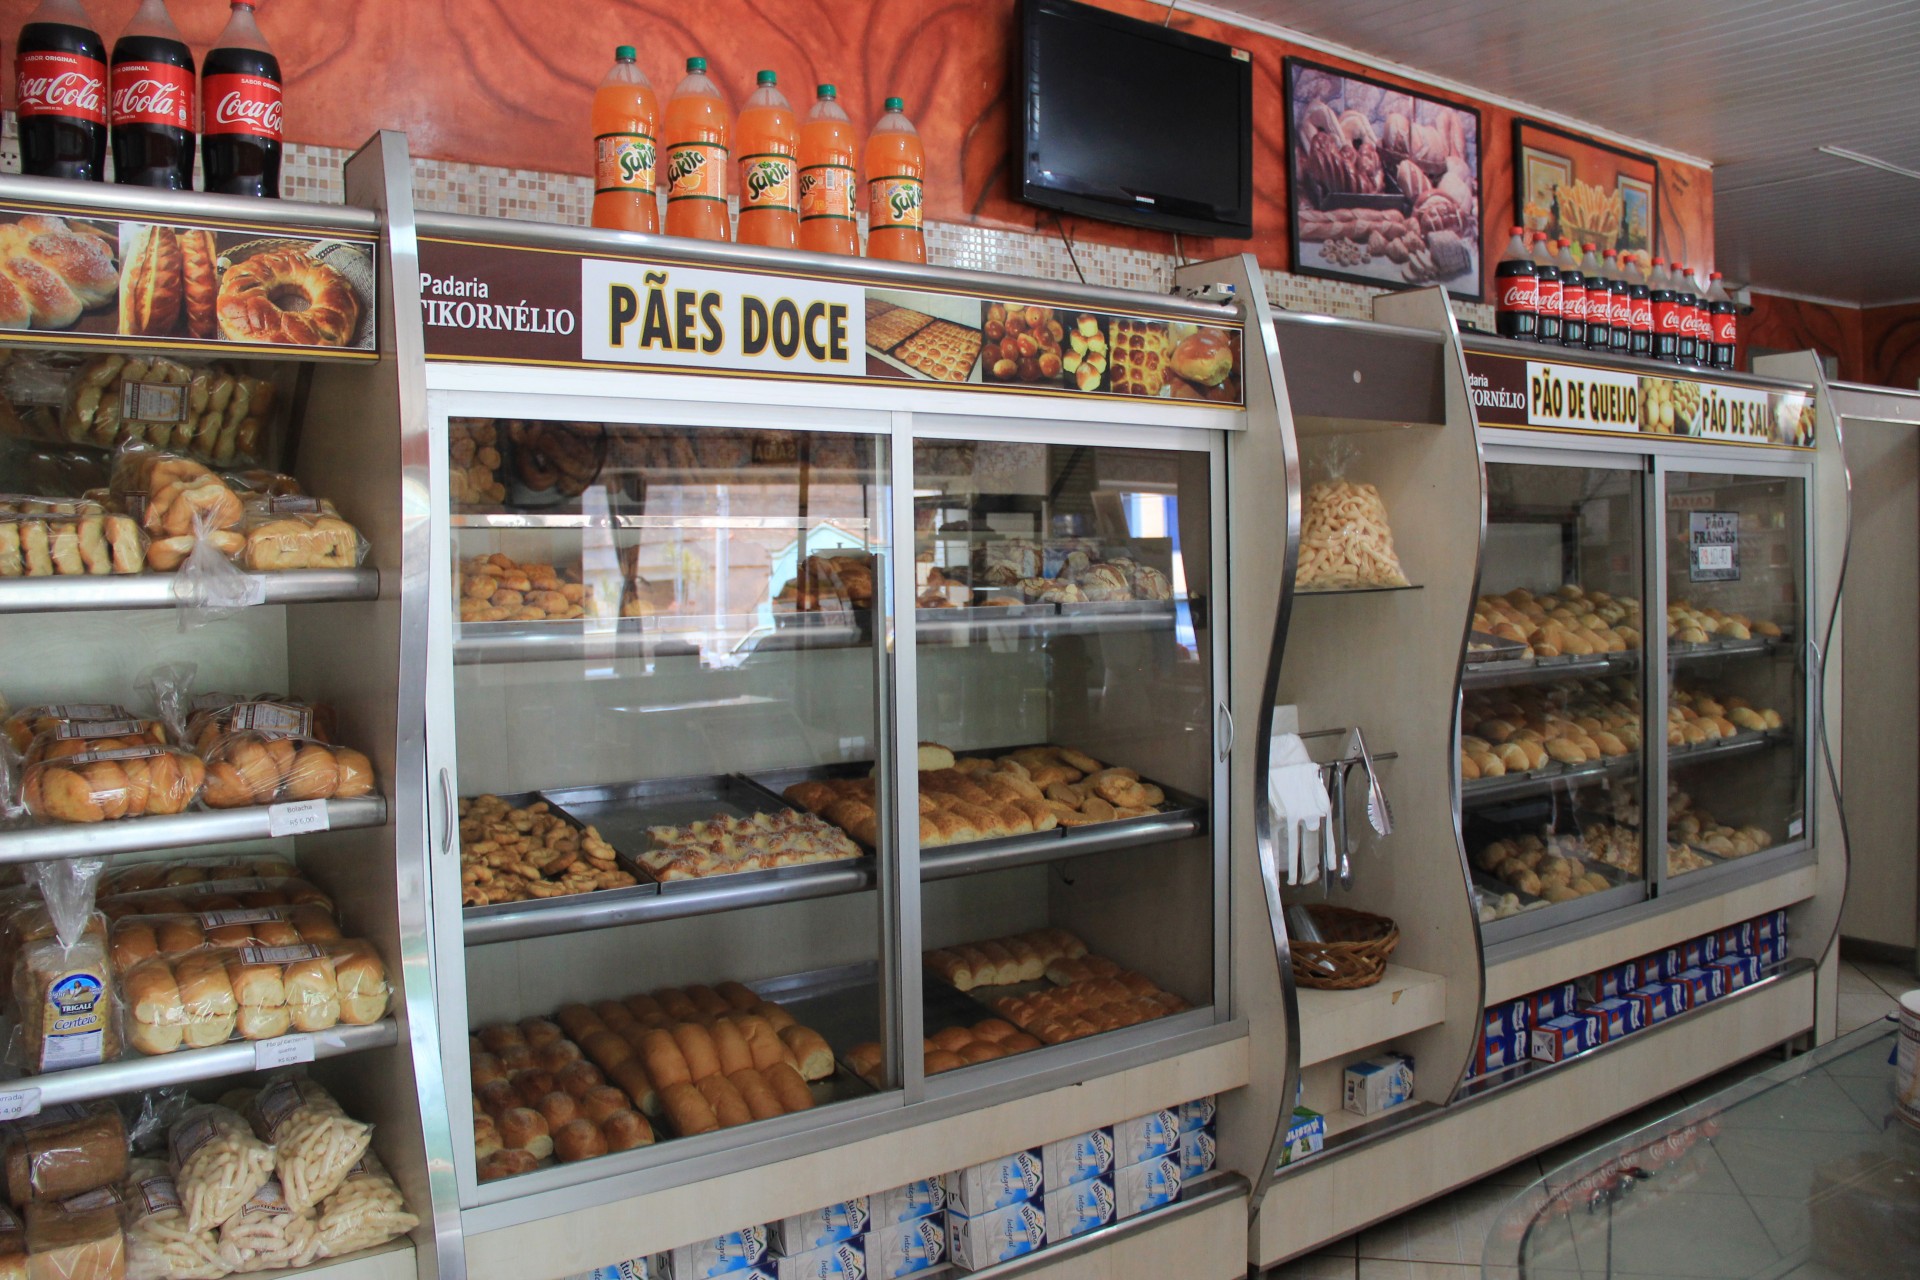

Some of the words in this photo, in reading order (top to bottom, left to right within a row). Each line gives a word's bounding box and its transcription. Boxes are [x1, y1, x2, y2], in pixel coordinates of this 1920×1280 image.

[420, 272, 489, 298] Padaria
[608, 270, 725, 354] PÃES
[740, 295, 850, 363] DOCE
[1471, 387, 1526, 409] ORNÉLIO
[1532, 367, 1563, 418] PÃO
[1567, 379, 1585, 419] DE
[1589, 382, 1637, 424] QUEIJO
[1702, 388, 1727, 433] PÃO
[1731, 400, 1745, 434] DE
[287, 804, 313, 813] Bolacha
[54, 1014, 97, 1030] Centeio
[62, 1003, 92, 1012] TRIGALE
[1159, 1110, 1172, 1147] Ibituruna
[1091, 1131, 1105, 1169] Ibituruna
[1001, 1165, 1012, 1195] Integral
[1017, 1153, 1034, 1192] Ibituruna
[1161, 1161, 1174, 1197] Ibituruna
[1076, 1194, 1087, 1223] Integral
[1092, 1182, 1107, 1220] Ibituruna
[919, 1222, 936, 1261] Ibituruna
[1004, 1218, 1015, 1248] Integral
[1021, 1206, 1038, 1245] Ibituruna
[902, 1235, 913, 1264] Integral
